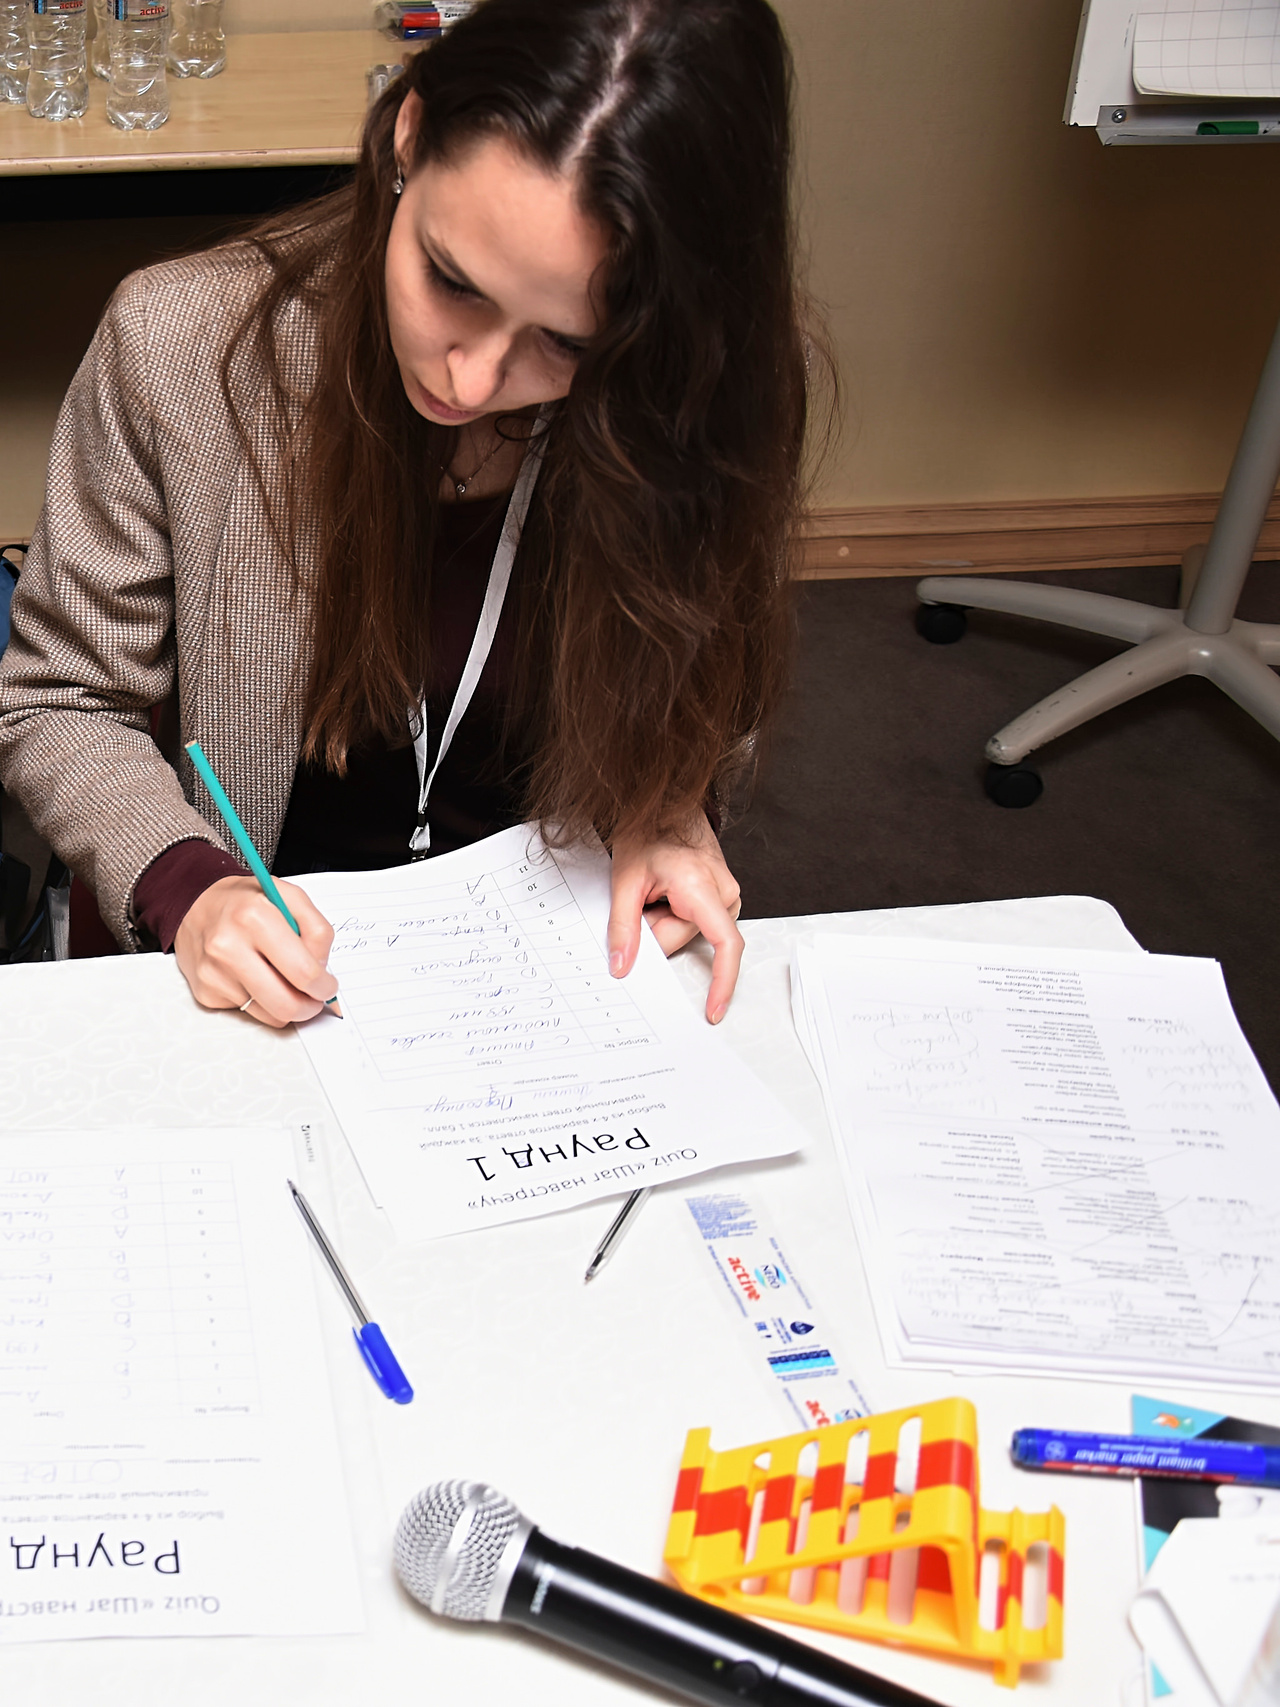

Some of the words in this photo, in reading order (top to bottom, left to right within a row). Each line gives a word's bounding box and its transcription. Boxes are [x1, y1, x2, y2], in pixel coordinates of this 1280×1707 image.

[519, 865, 529, 874] 11
[527, 883, 538, 893] 10
[538, 901, 545, 909] 9
[616, 1037, 649, 1047] Вопрос
[476, 1059, 502, 1067] Ответ
[576, 1093, 645, 1113] правильный
[627, 1102, 666, 1117] Выбор
[542, 1107, 572, 1118] ответ
[611, 1111, 625, 1120] из
[468, 1113, 540, 1129] начисляется
[528, 1117, 589, 1135] вариантов
[419, 1139, 465, 1150] каждый
[468, 1136, 481, 1144] За
[501, 1127, 651, 1169] Раунд
[651, 1147, 698, 1167] Quiz
[466, 1156, 496, 1182] 1
[591, 1163, 646, 1184] «Шаг
[467, 1175, 586, 1210] навстречу»
[727, 1256, 761, 1302] active
[1074, 1449, 1118, 1466] marker
[1120, 1452, 1157, 1468] paper
[1157, 1455, 1207, 1472] brilliant
[78, 1492, 116, 1501] ответ
[121, 1489, 209, 1500] правильный
[53, 1512, 128, 1523] вариантов
[157, 1512, 173, 1520] из
[177, 1509, 225, 1520] Выбор
[10, 1532, 182, 1575] Раунд
[85, 1596, 154, 1615] «Шаг
[164, 1594, 221, 1615] Quiz
